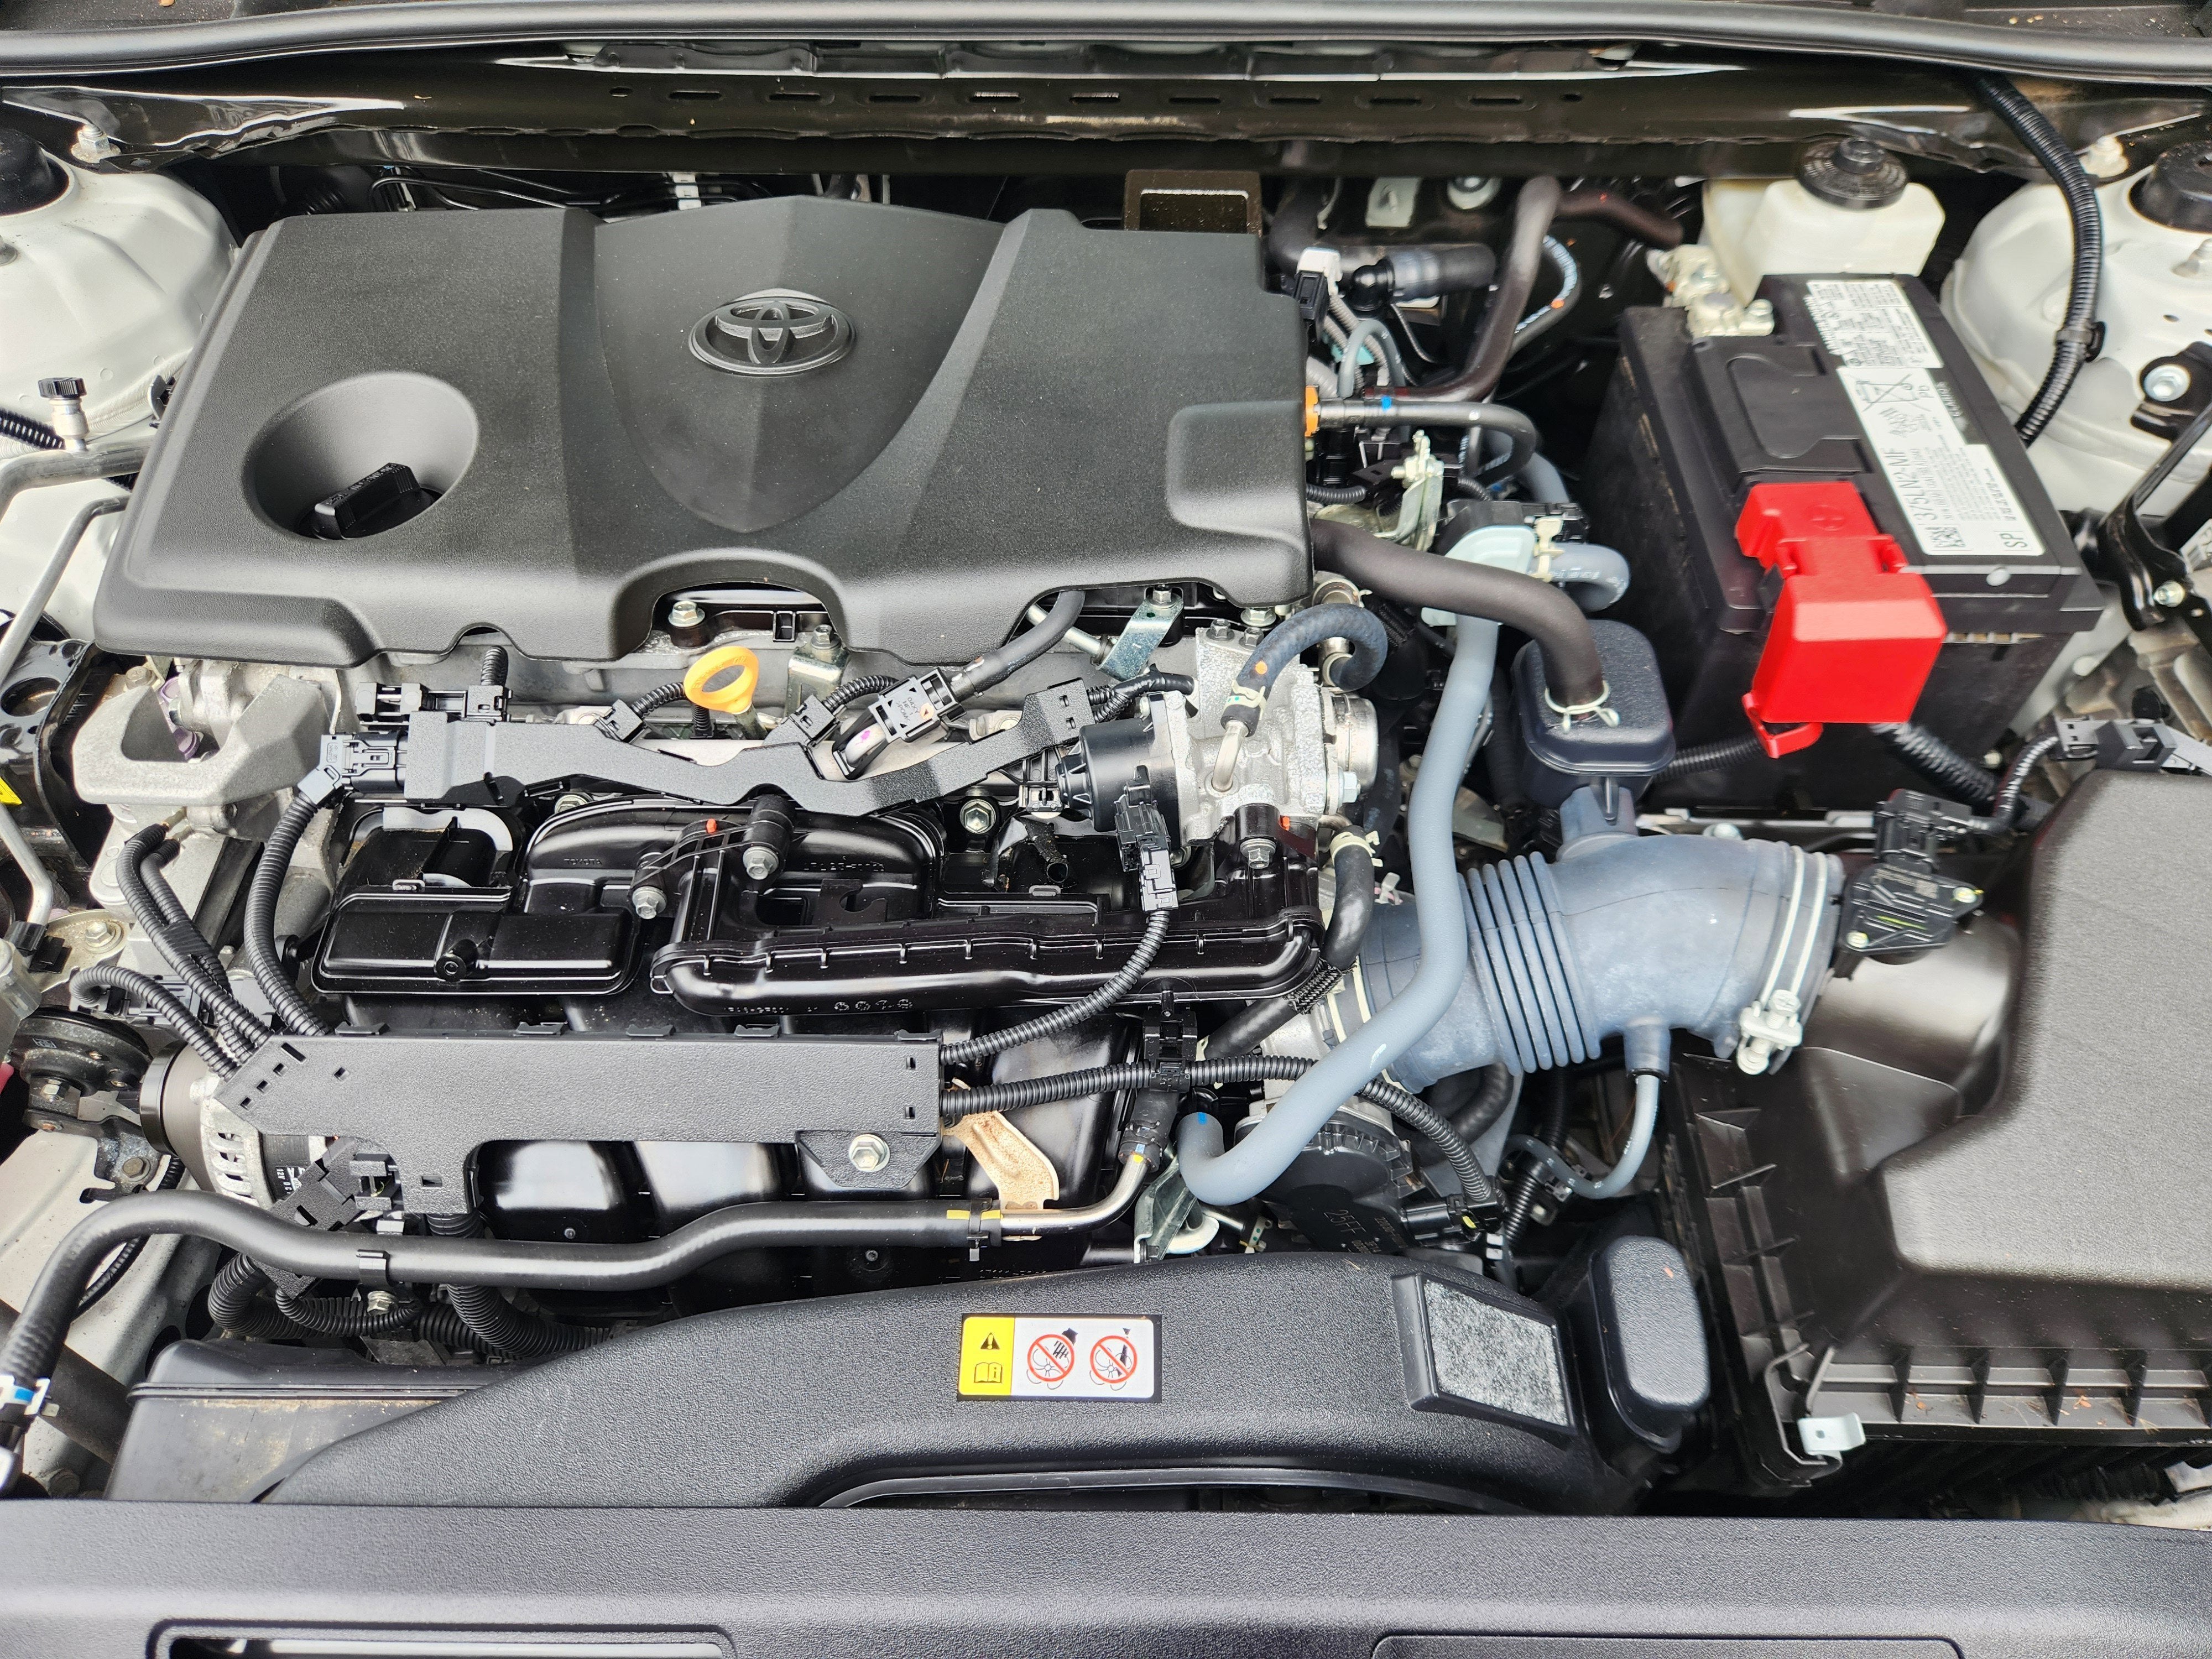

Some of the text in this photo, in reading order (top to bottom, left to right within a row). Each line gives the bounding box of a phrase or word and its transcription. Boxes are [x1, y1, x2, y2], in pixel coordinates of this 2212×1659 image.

[1915, 385, 1935, 398] Pb
[2000, 533, 2028, 547] SP
[1323, 1209, 1368, 1235] 25FF
